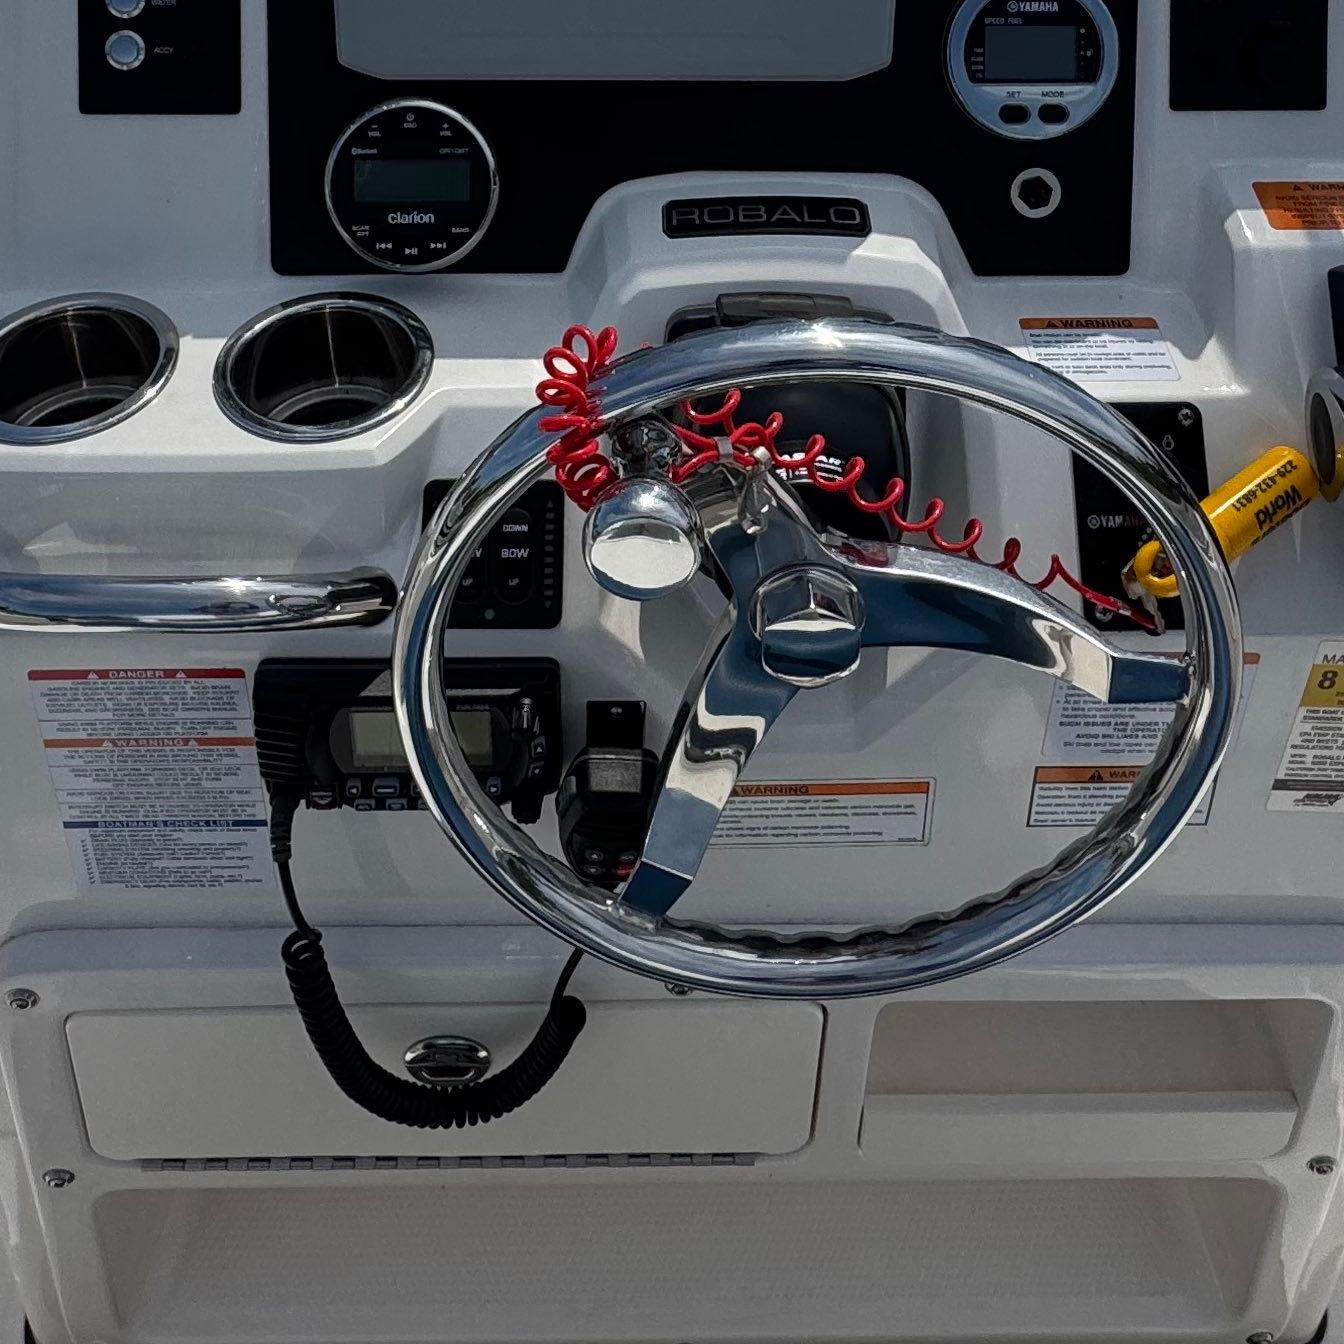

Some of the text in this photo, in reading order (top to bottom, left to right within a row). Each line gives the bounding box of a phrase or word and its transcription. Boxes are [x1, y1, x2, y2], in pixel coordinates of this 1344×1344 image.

[1019, 1, 1059, 12] YAMAHA
[387, 211, 435, 225] clarion
[670, 205, 862, 226] ROBALO
[1061, 319, 1134, 328] WARNING
[1254, 484, 1303, 531] World
[502, 524, 529, 532] DOWN
[500, 548, 529, 558] BOW
[109, 670, 165, 678] DANGER
[1317, 670, 1338, 690] 8
[115, 739, 185, 747] WARNING
[741, 785, 809, 795] WARNING
